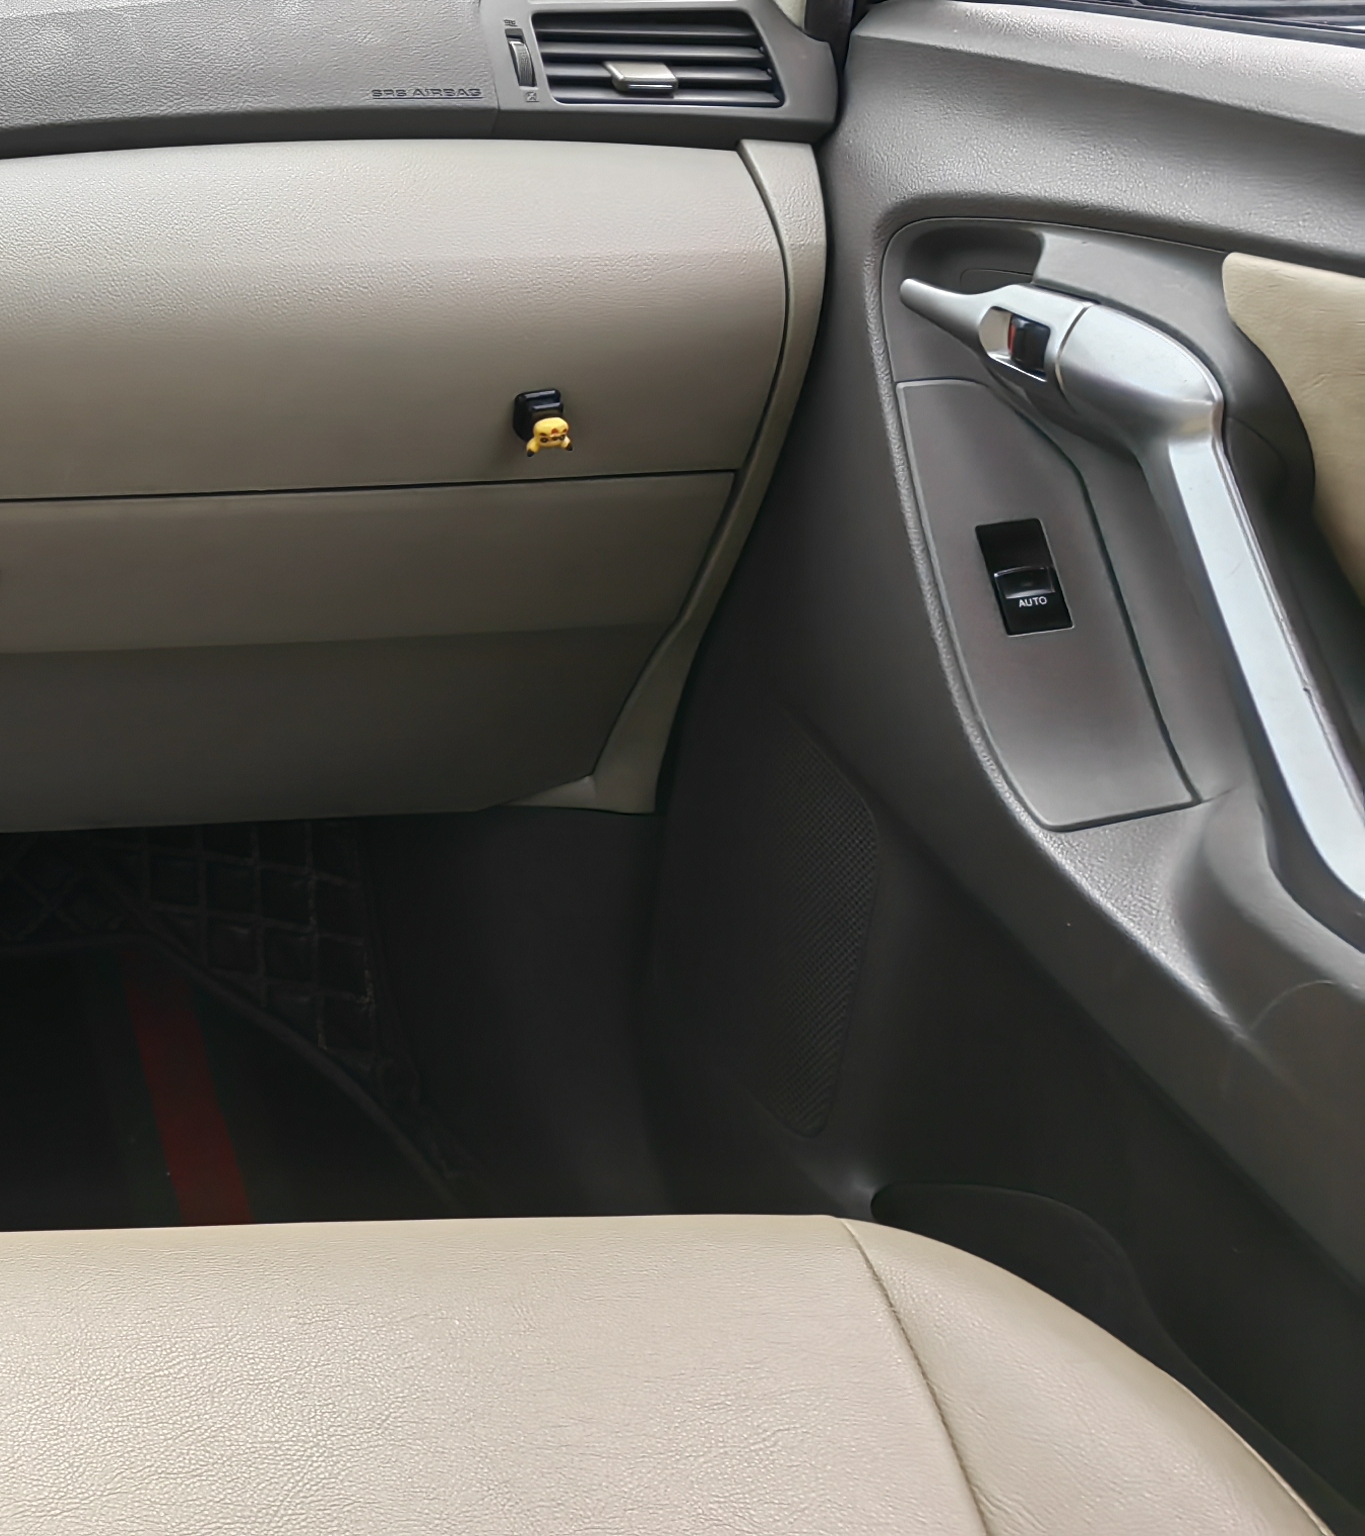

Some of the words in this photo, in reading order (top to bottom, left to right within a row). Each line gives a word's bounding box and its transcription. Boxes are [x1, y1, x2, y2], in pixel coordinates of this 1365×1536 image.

[371, 89, 407, 97] SRS
[412, 88, 482, 97] AIRBAG
[1019, 596, 1047, 608] AUTO
